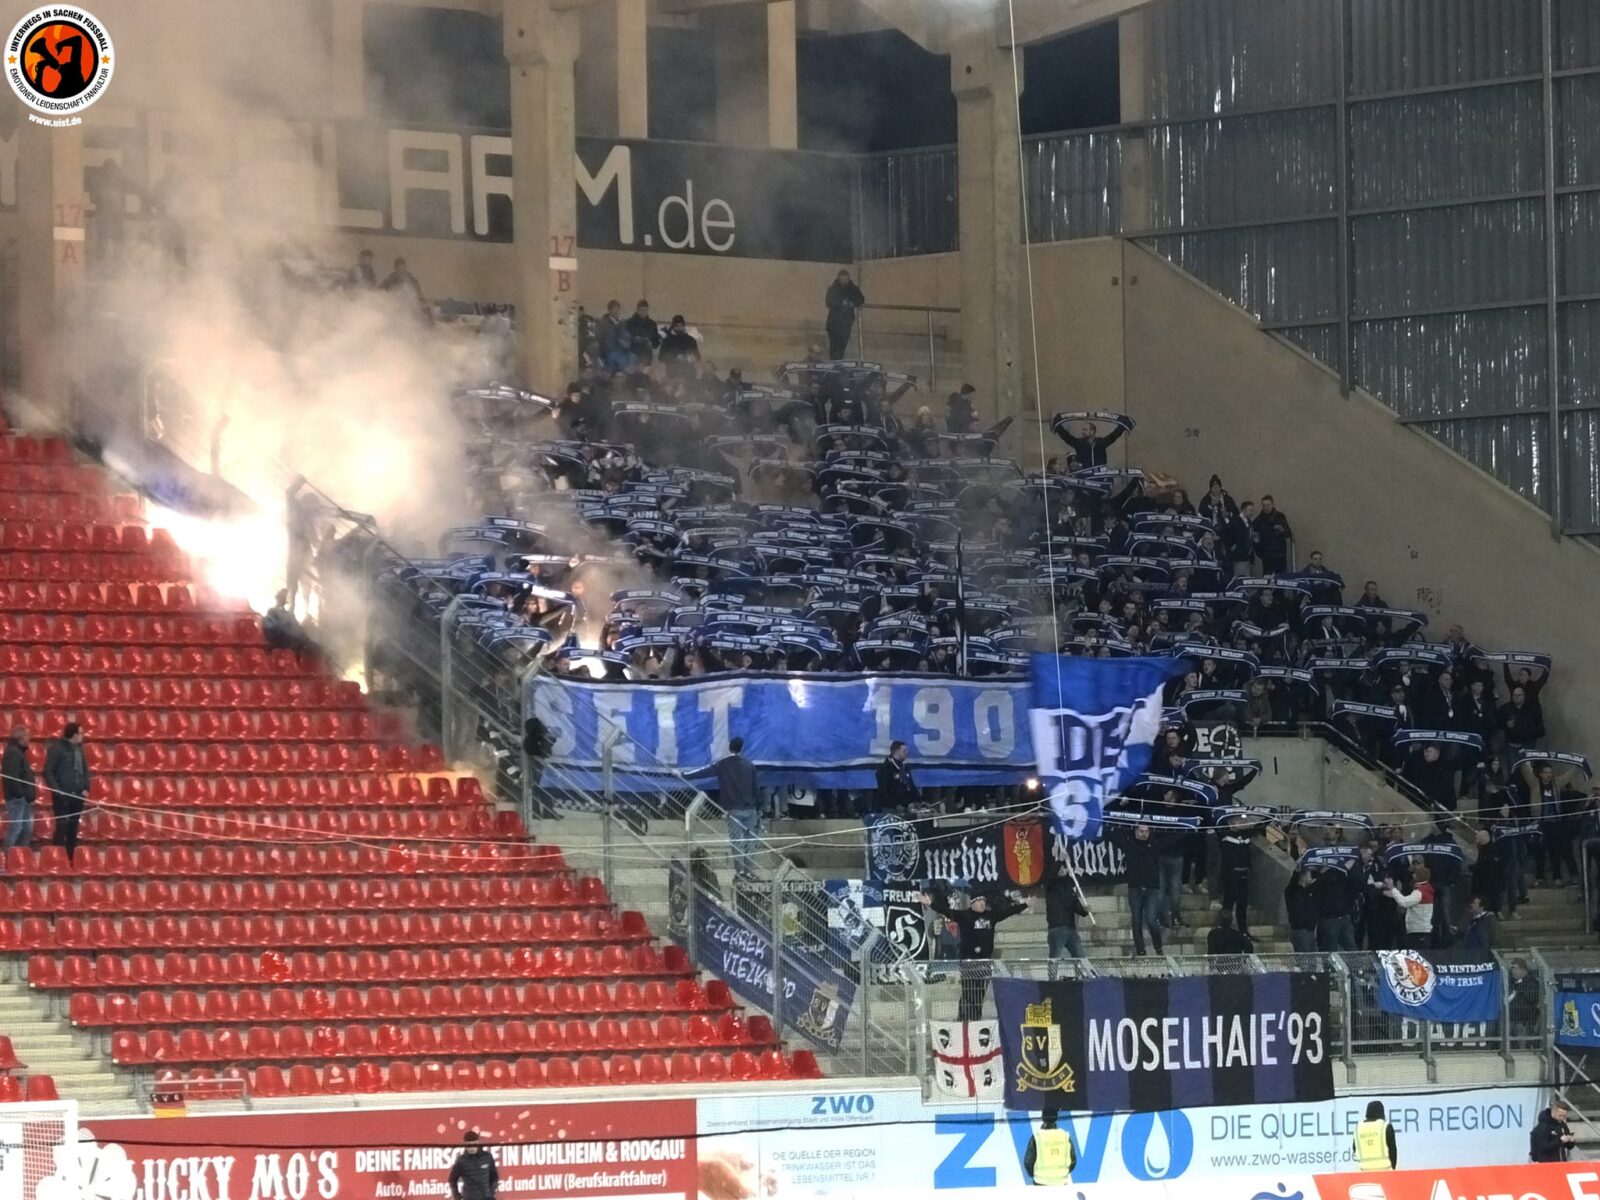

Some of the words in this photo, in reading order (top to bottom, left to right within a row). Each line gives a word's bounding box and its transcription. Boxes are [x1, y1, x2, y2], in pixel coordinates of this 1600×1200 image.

[551, 236, 575, 257] 17
[557, 270, 572, 292] B
[534, 683, 744, 765] SEIT
[1088, 1011, 1324, 1072] MOSELHAIE'93
[811, 1094, 875, 1115] ZWO
[1211, 1114, 1251, 1140] DIE
[1260, 1110, 1359, 1138] QUELLE
[1429, 1103, 1523, 1131] REGION
[356, 1149, 401, 1173] DEINE
[502, 1146, 519, 1167] IN
[605, 1141, 618, 1160] &
[620, 1138, 686, 1160] RODGAU!
[788, 1150, 822, 1160] QUELLE
[823, 1149, 841, 1160] DER
[843, 1148, 876, 1159] REGION
[858, 1160, 876, 1169] DAS
[933, 1108, 1194, 1190] ZWO
[375, 1180, 407, 1199] Auto,
[514, 1177, 537, 1192] und
[538, 1174, 563, 1191] LKW
[564, 1168, 667, 1191] (Berufskraftfahrer)
